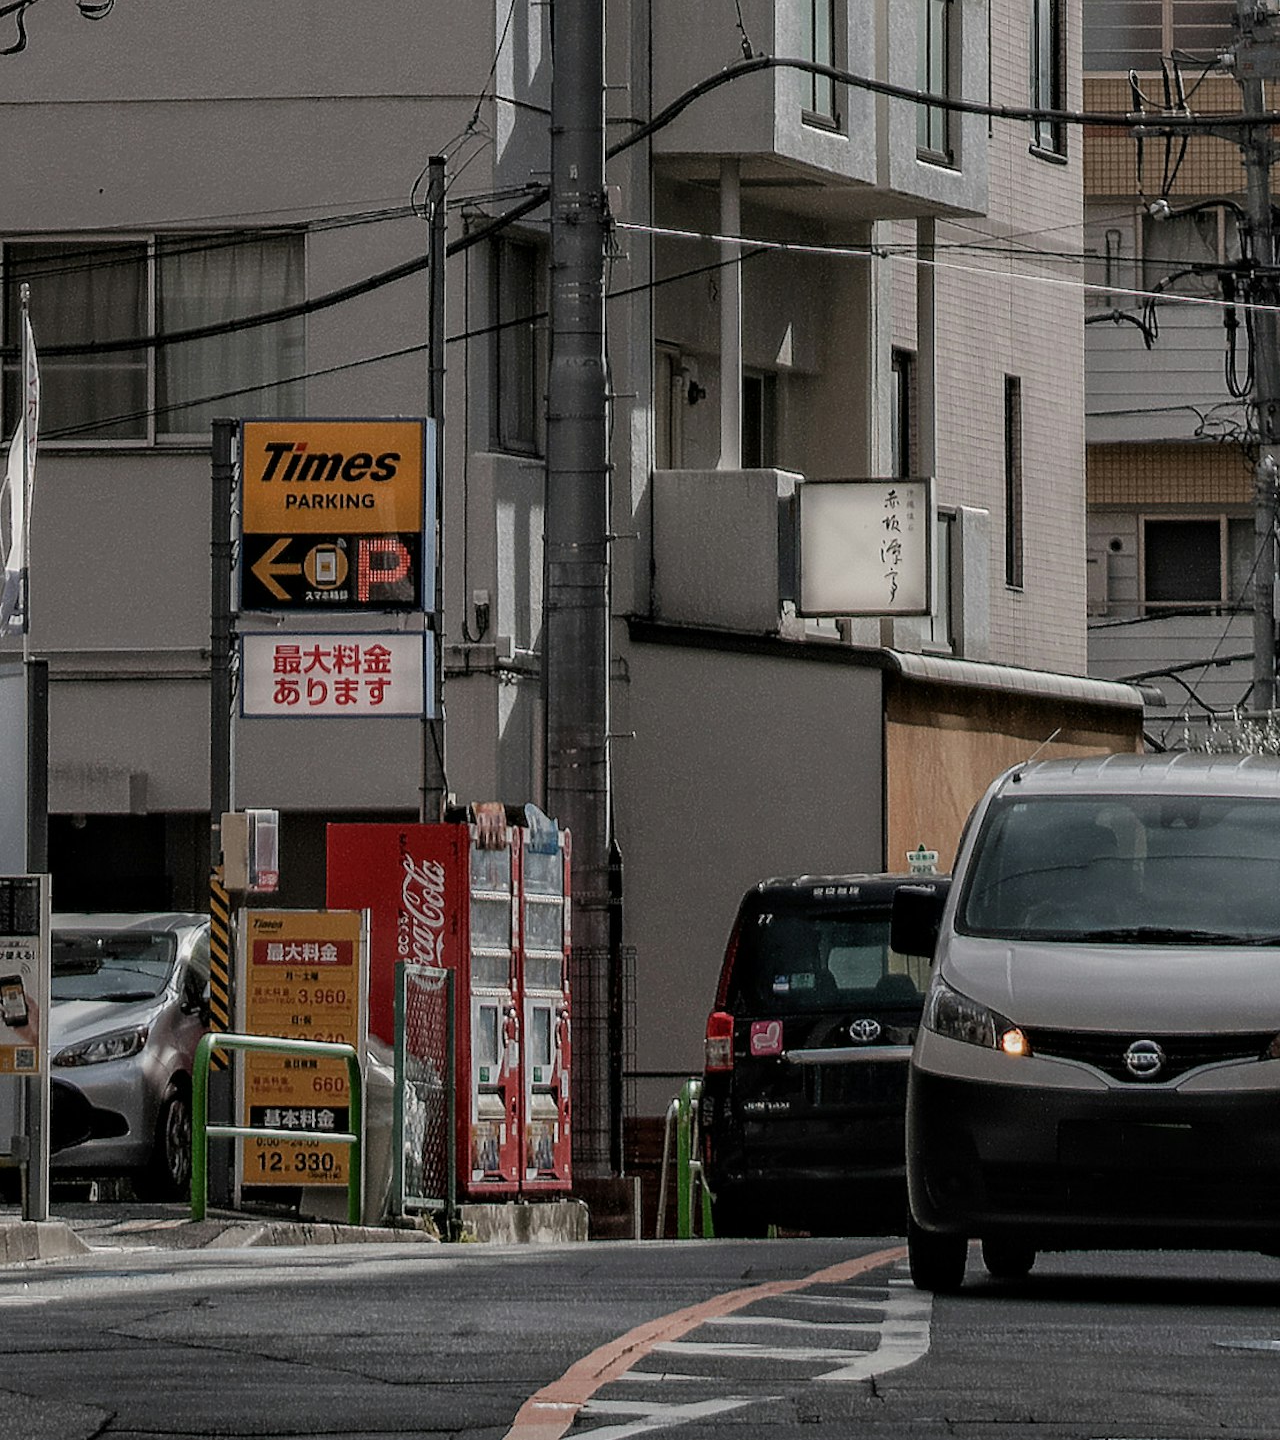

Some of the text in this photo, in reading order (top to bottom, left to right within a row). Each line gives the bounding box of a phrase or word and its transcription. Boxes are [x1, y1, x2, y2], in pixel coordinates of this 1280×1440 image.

[261, 442, 401, 482] Times
[286, 494, 375, 509] PARKING
[273, 644, 392, 674] 最大料金
[273, 678, 392, 706] あります
[253, 919, 283, 929] Times
[267, 943, 337, 961] 最大料金
[264, 1109, 334, 1128] 基本料金
